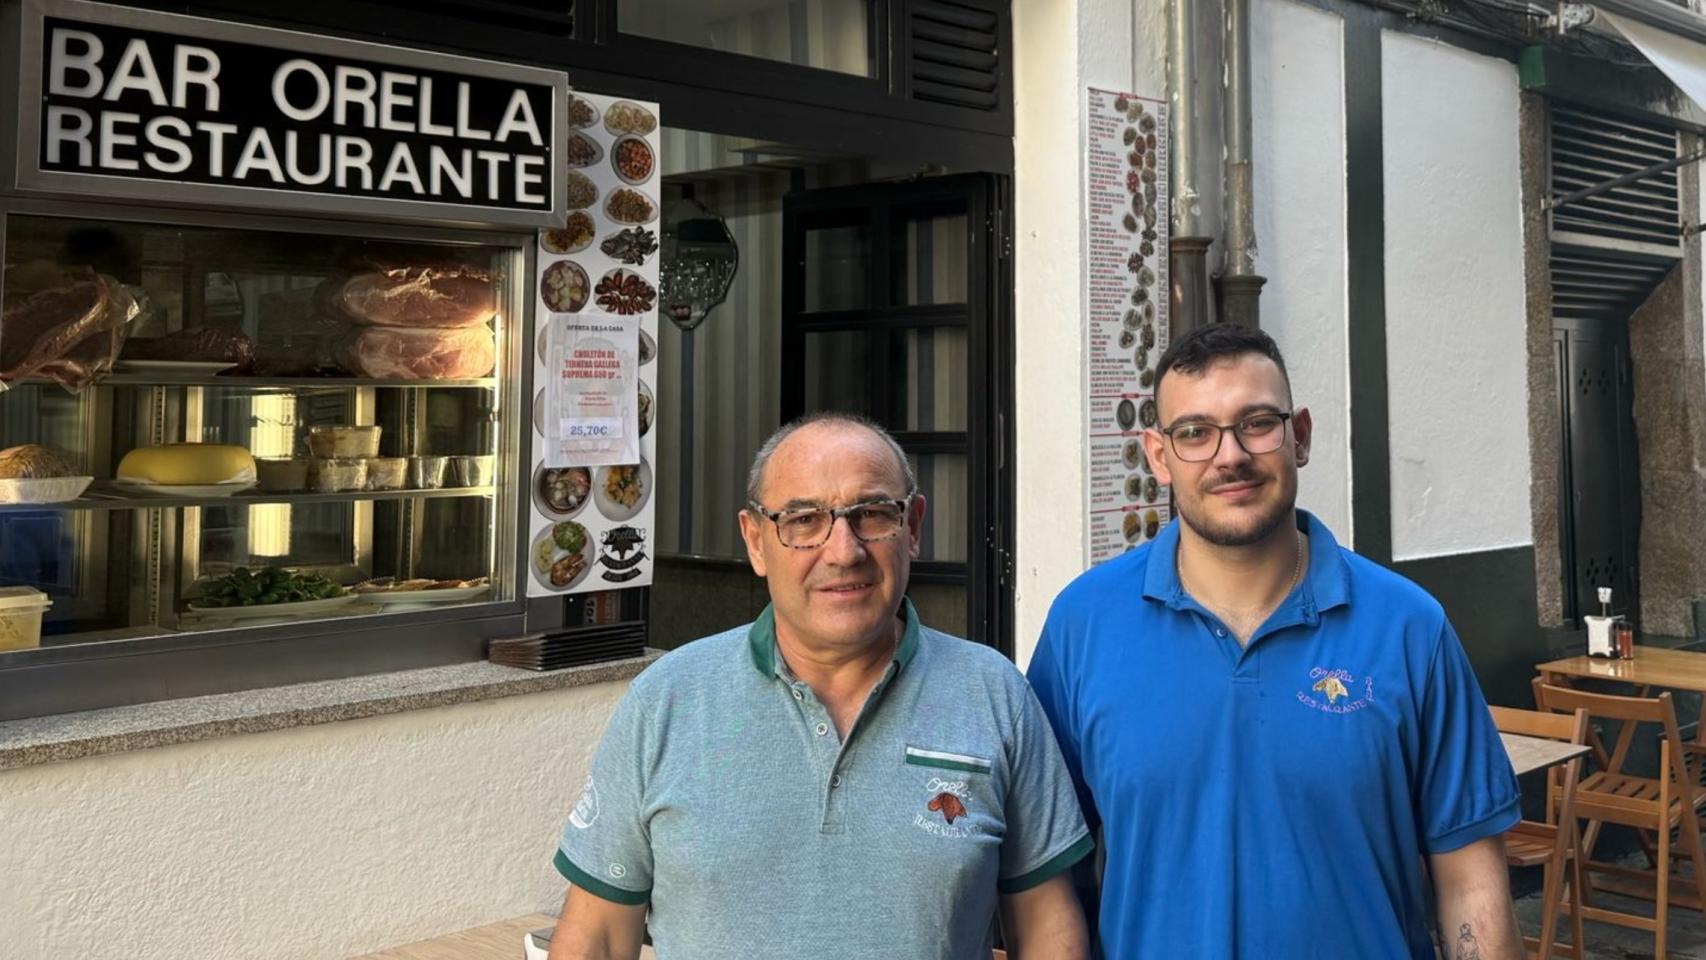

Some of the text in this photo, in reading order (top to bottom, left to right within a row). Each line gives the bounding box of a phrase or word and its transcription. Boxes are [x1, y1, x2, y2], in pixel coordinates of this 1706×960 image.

[48, 27, 546, 147] BAR ORELLA
[46, 105, 547, 204] RESTAURANTE
[565, 360, 620, 369] TERNERA GALLEGA
[1309, 666, 1355, 683] Orella
[1296, 690, 1367, 714] RESTAURANTE
